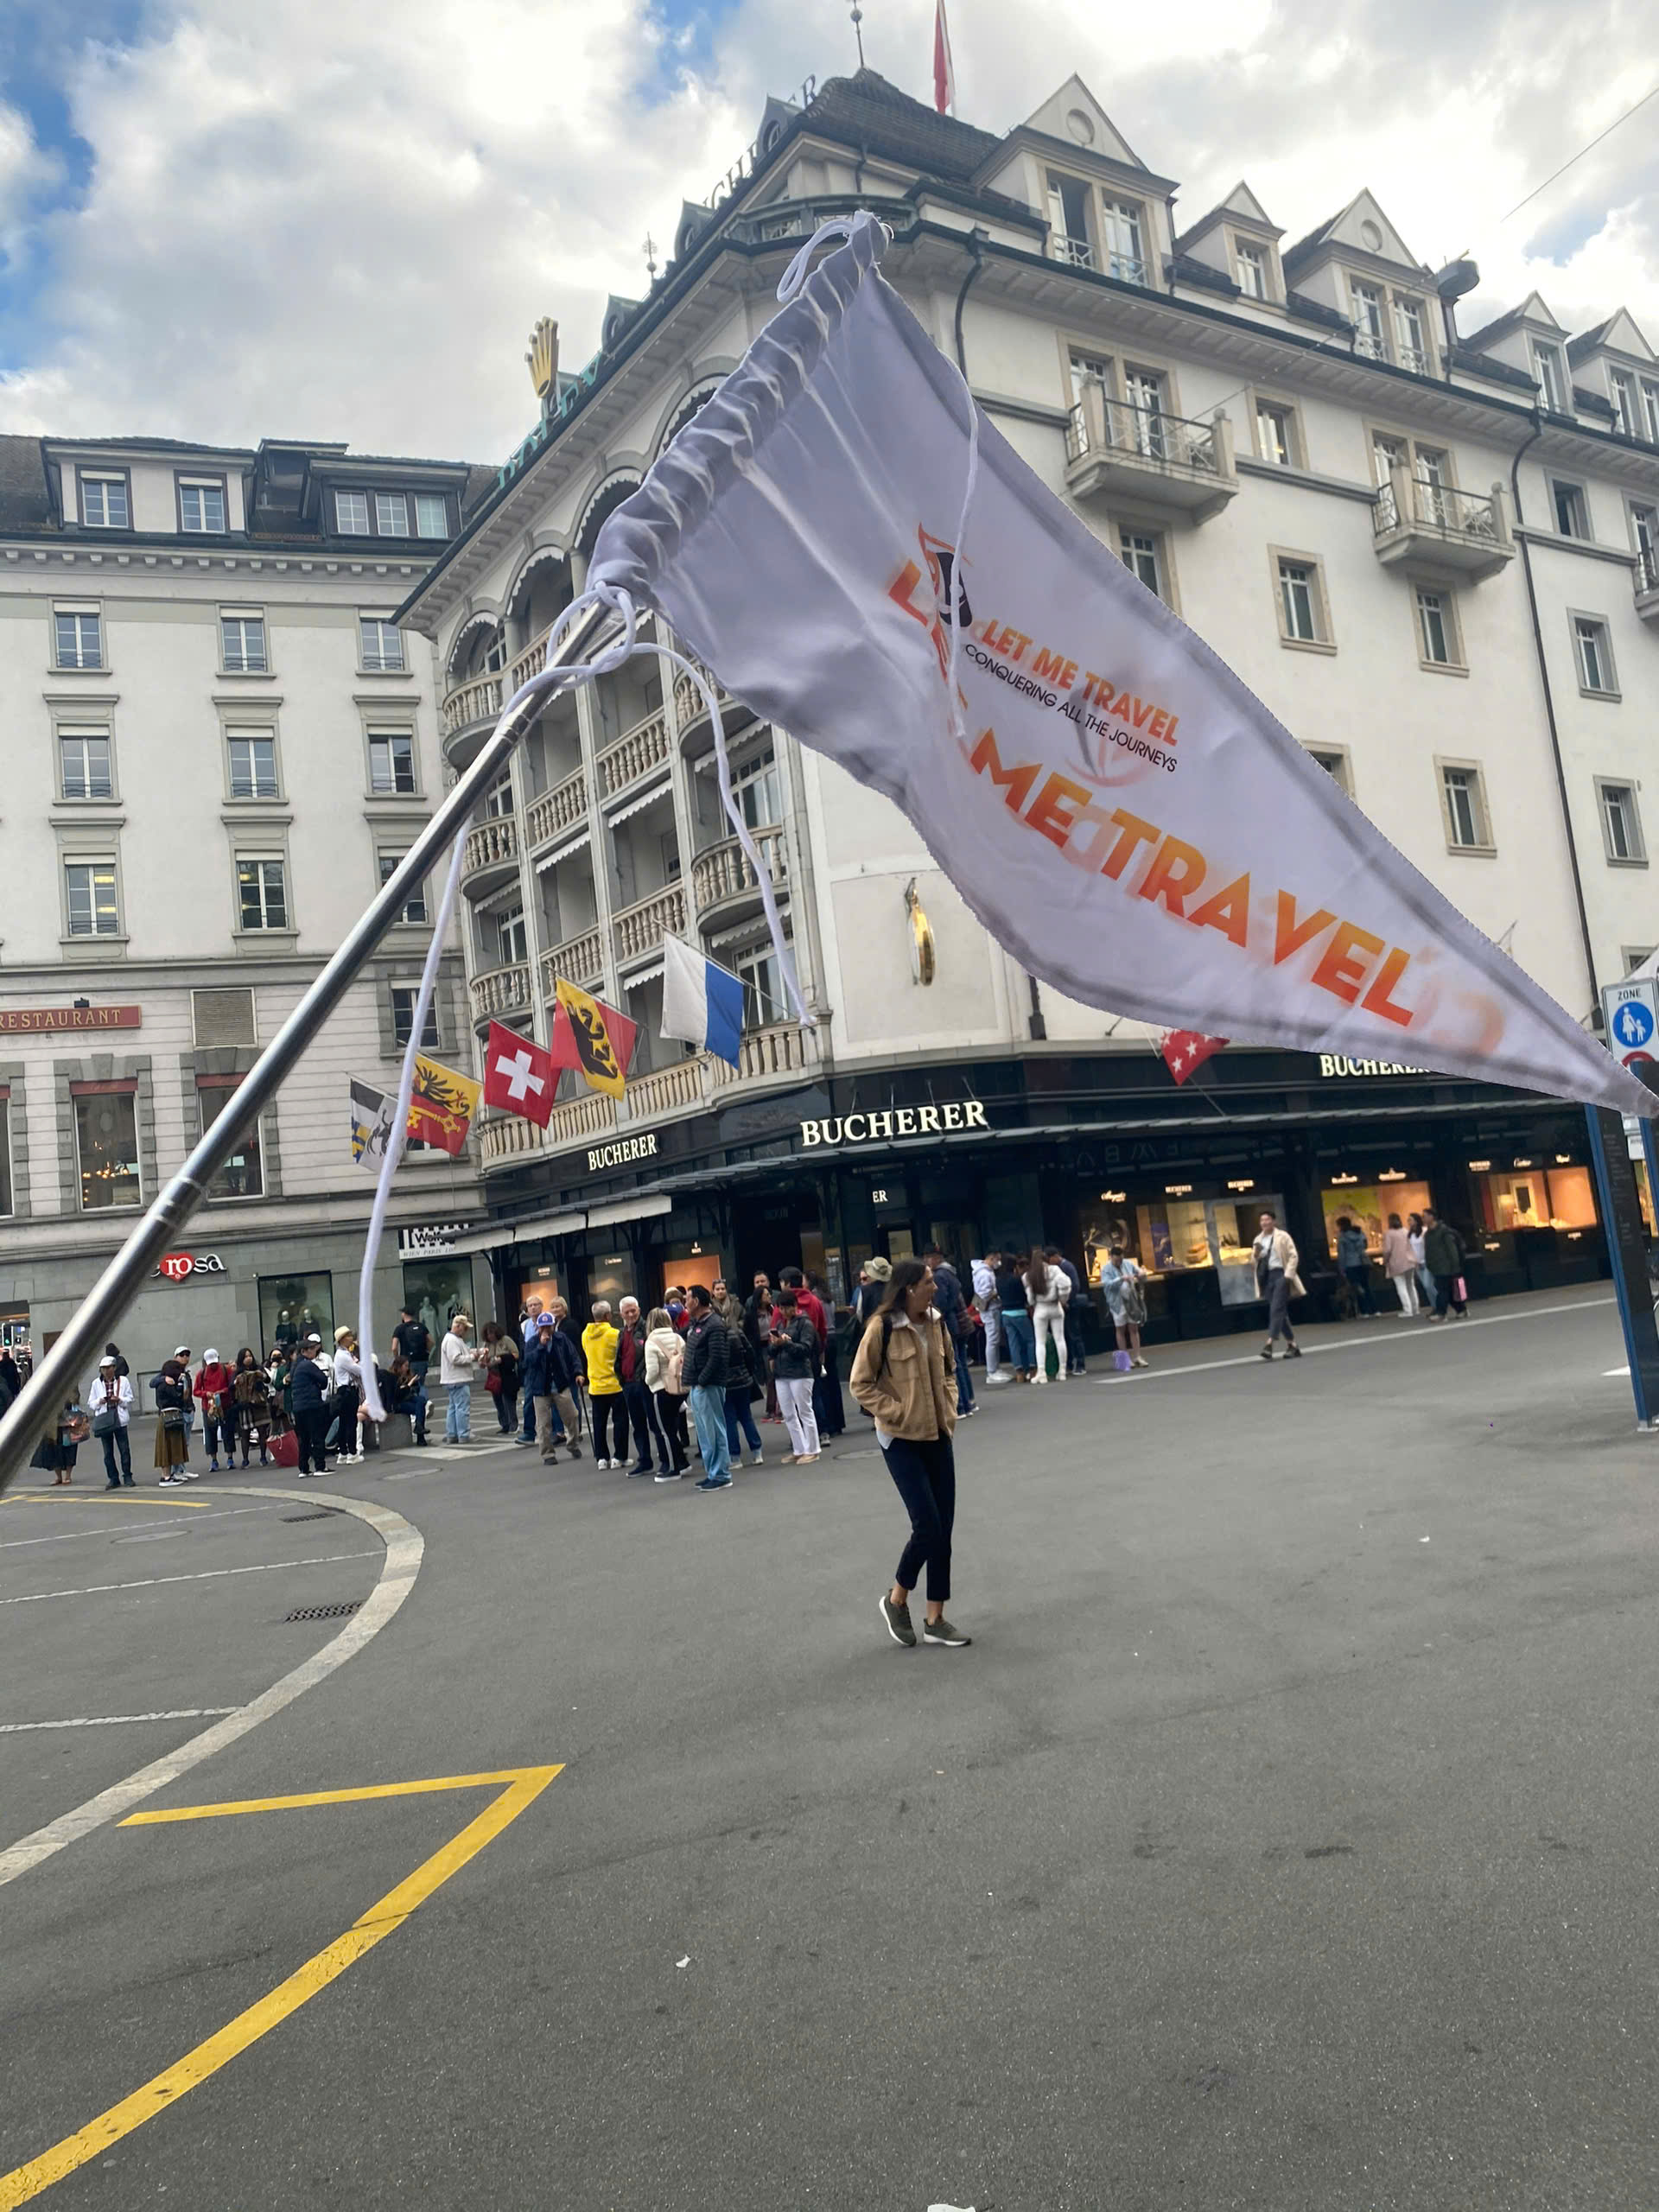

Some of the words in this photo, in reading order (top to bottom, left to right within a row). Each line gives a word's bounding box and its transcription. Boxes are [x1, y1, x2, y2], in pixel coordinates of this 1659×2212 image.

[982, 620, 1033, 661] LET
[1033, 646, 1078, 690] ME
[1082, 671, 1180, 747] TRAVEL
[965, 644, 1058, 707] CONQUERING
[1057, 702, 1082, 724] ALL
[1084, 714, 1109, 736] THE
[1109, 728, 1178, 772] JOURNEYS
[1618, 988, 1642, 1001] ZONE
[1319, 1054, 1431, 1077] BUCHE
[800, 1101, 988, 1147] BUCHERER
[588, 1134, 658, 1171] BUCHERER
